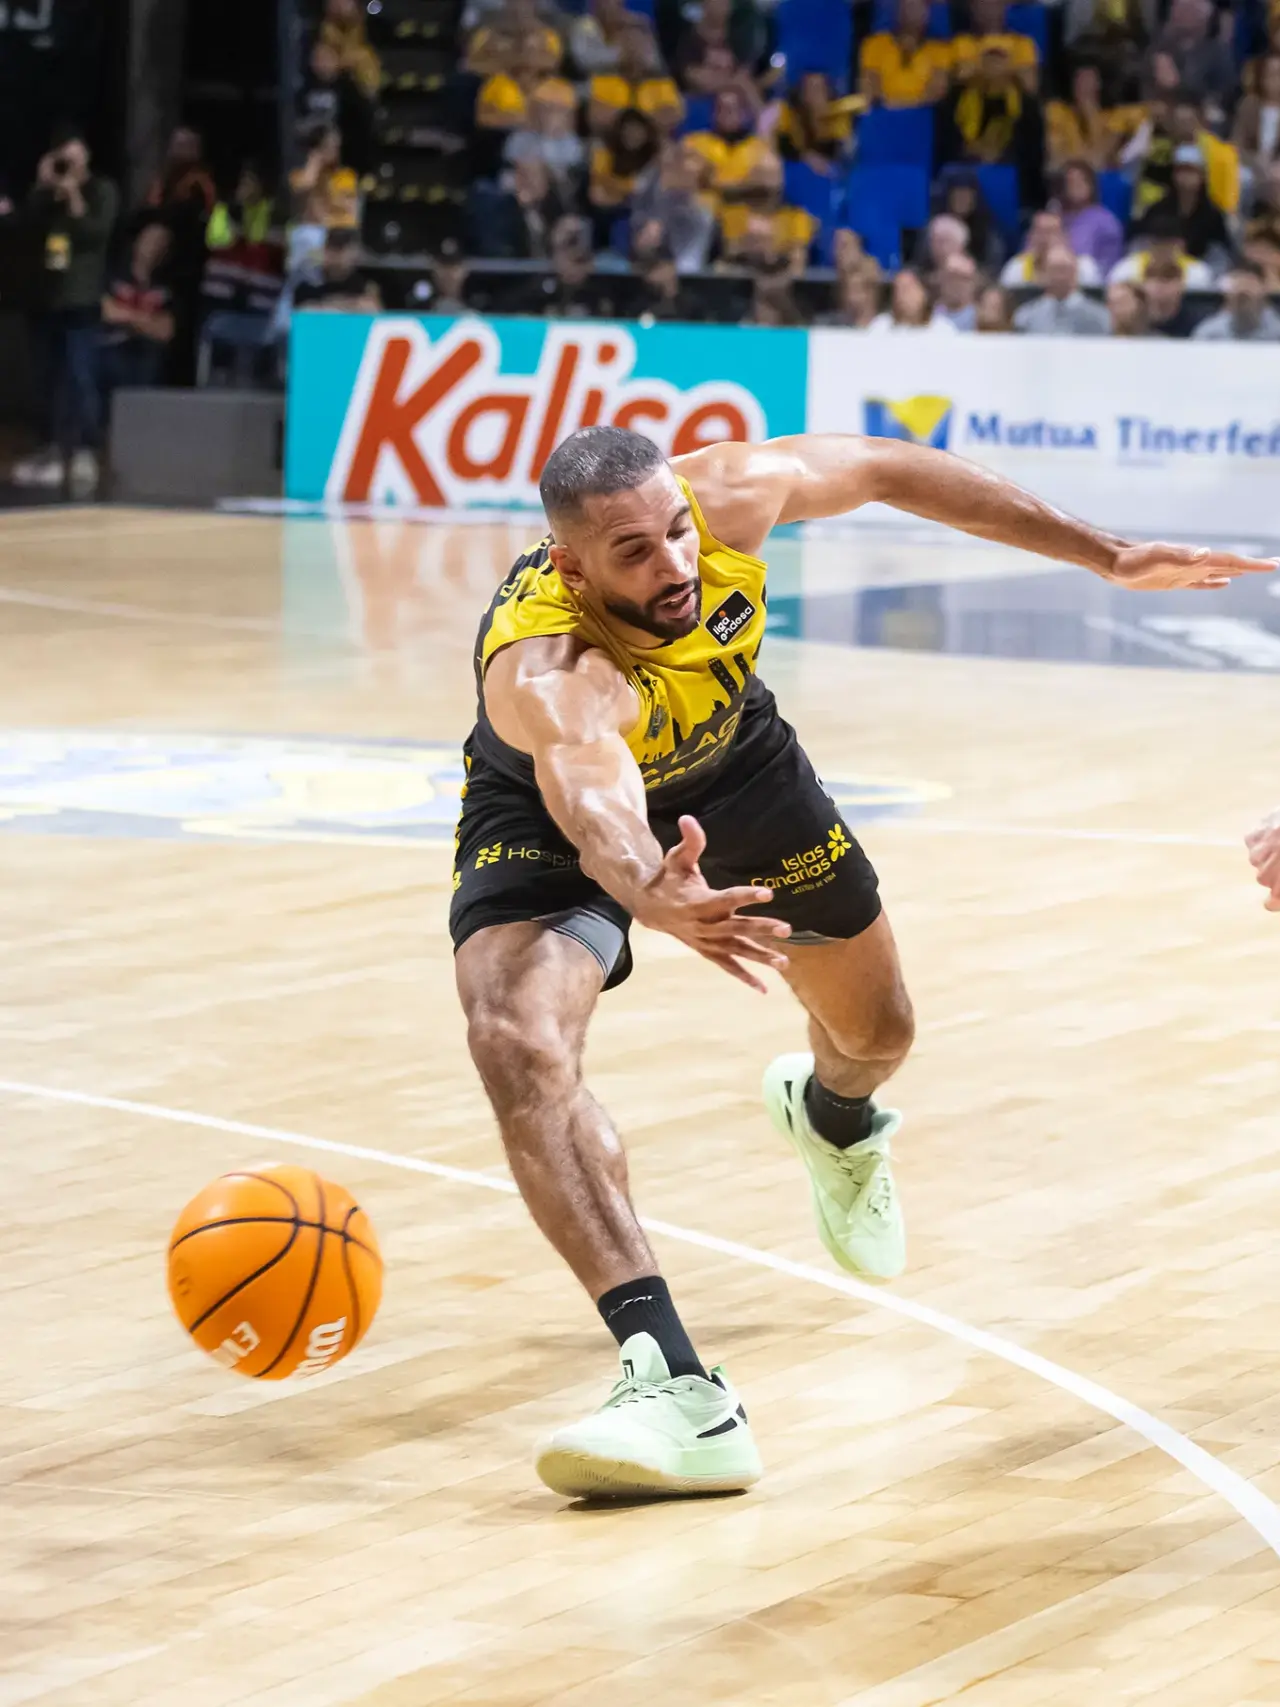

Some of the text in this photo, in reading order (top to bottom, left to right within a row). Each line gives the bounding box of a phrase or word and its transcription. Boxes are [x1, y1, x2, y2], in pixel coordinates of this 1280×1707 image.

[967, 412, 1098, 449] Mutua
[713, 616, 731, 636] liga
[720, 606, 753, 641] endesa
[782, 845, 825, 872] Islas
